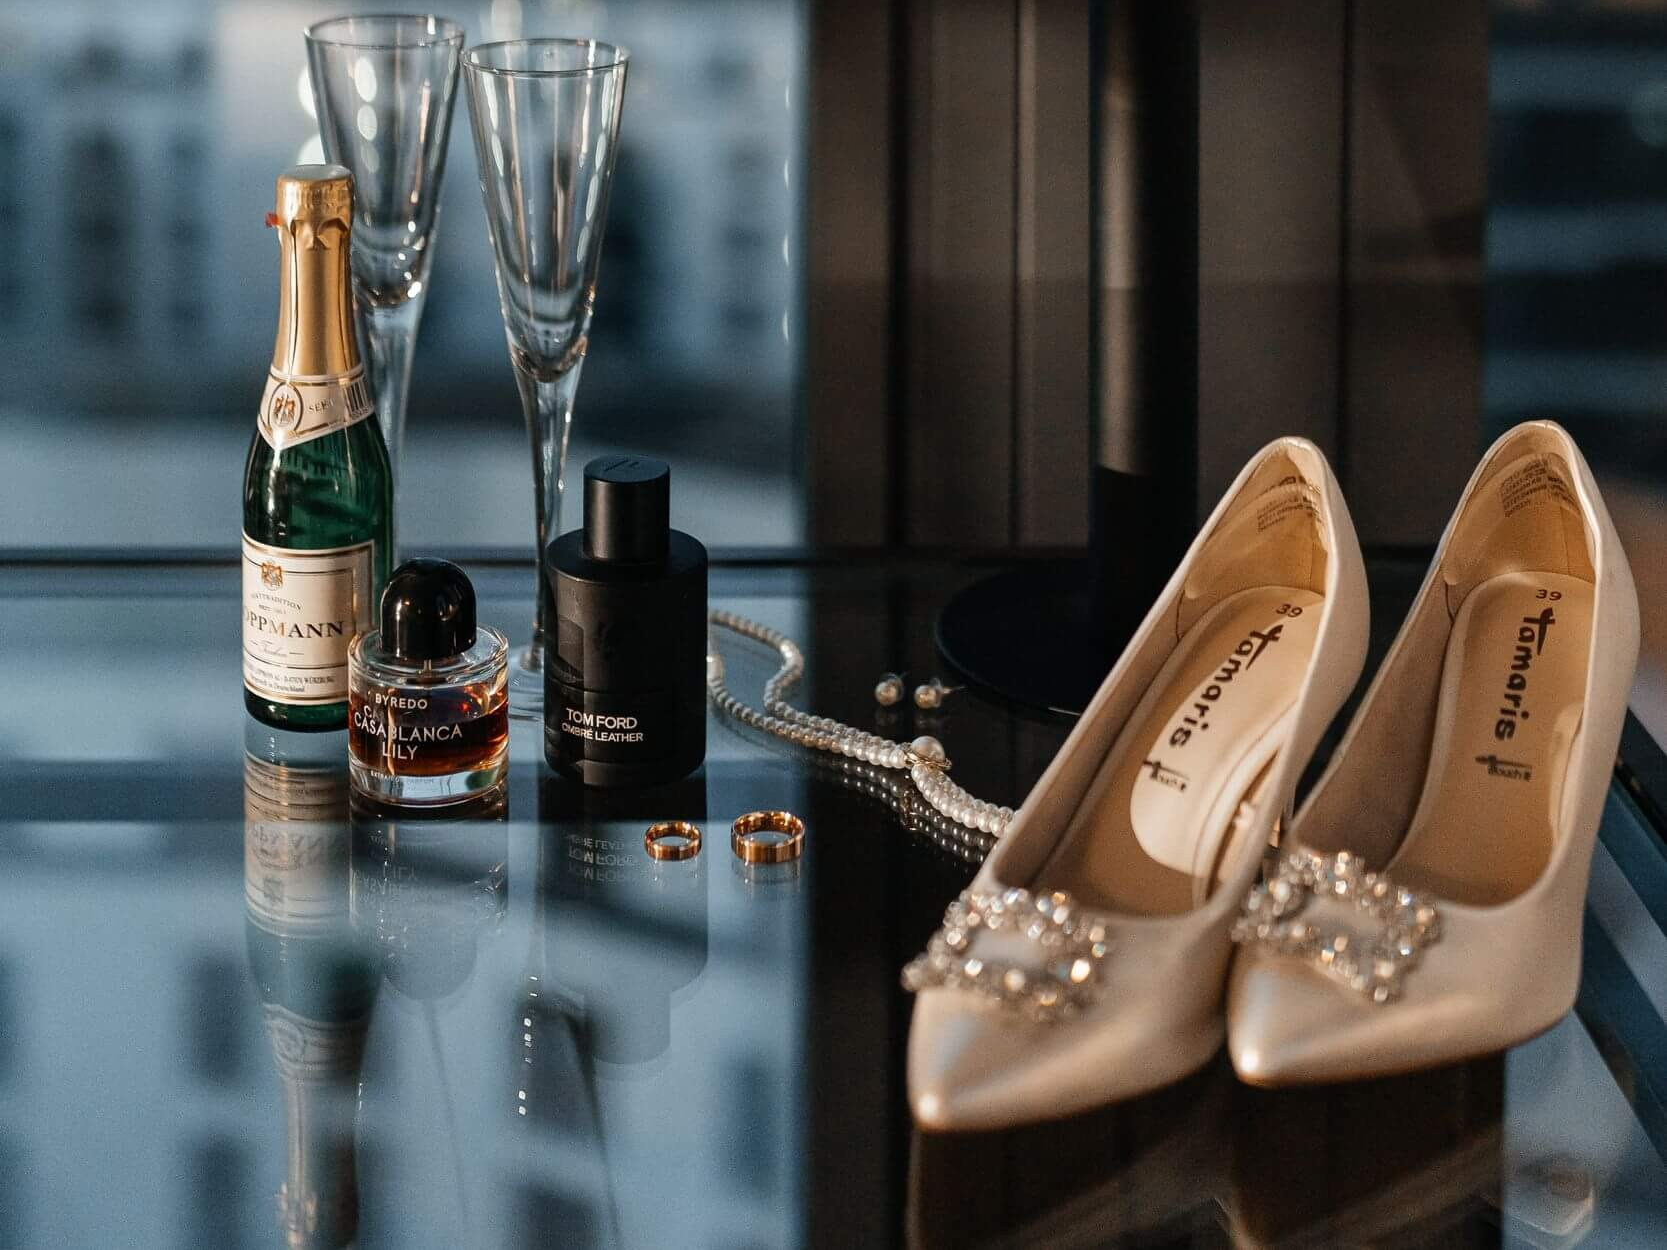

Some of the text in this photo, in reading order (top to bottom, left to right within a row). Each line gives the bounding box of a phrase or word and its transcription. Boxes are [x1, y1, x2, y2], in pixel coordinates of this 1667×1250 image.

[1535, 589, 1562, 601] 39
[1276, 603, 1303, 618] 39
[375, 693, 428, 710] BYREDO
[354, 711, 463, 743] CASABLANCA
[567, 707, 637, 730] TOM FORD
[562, 723, 643, 742] OMBRÉ LEATHER
[382, 742, 418, 760] LILY
